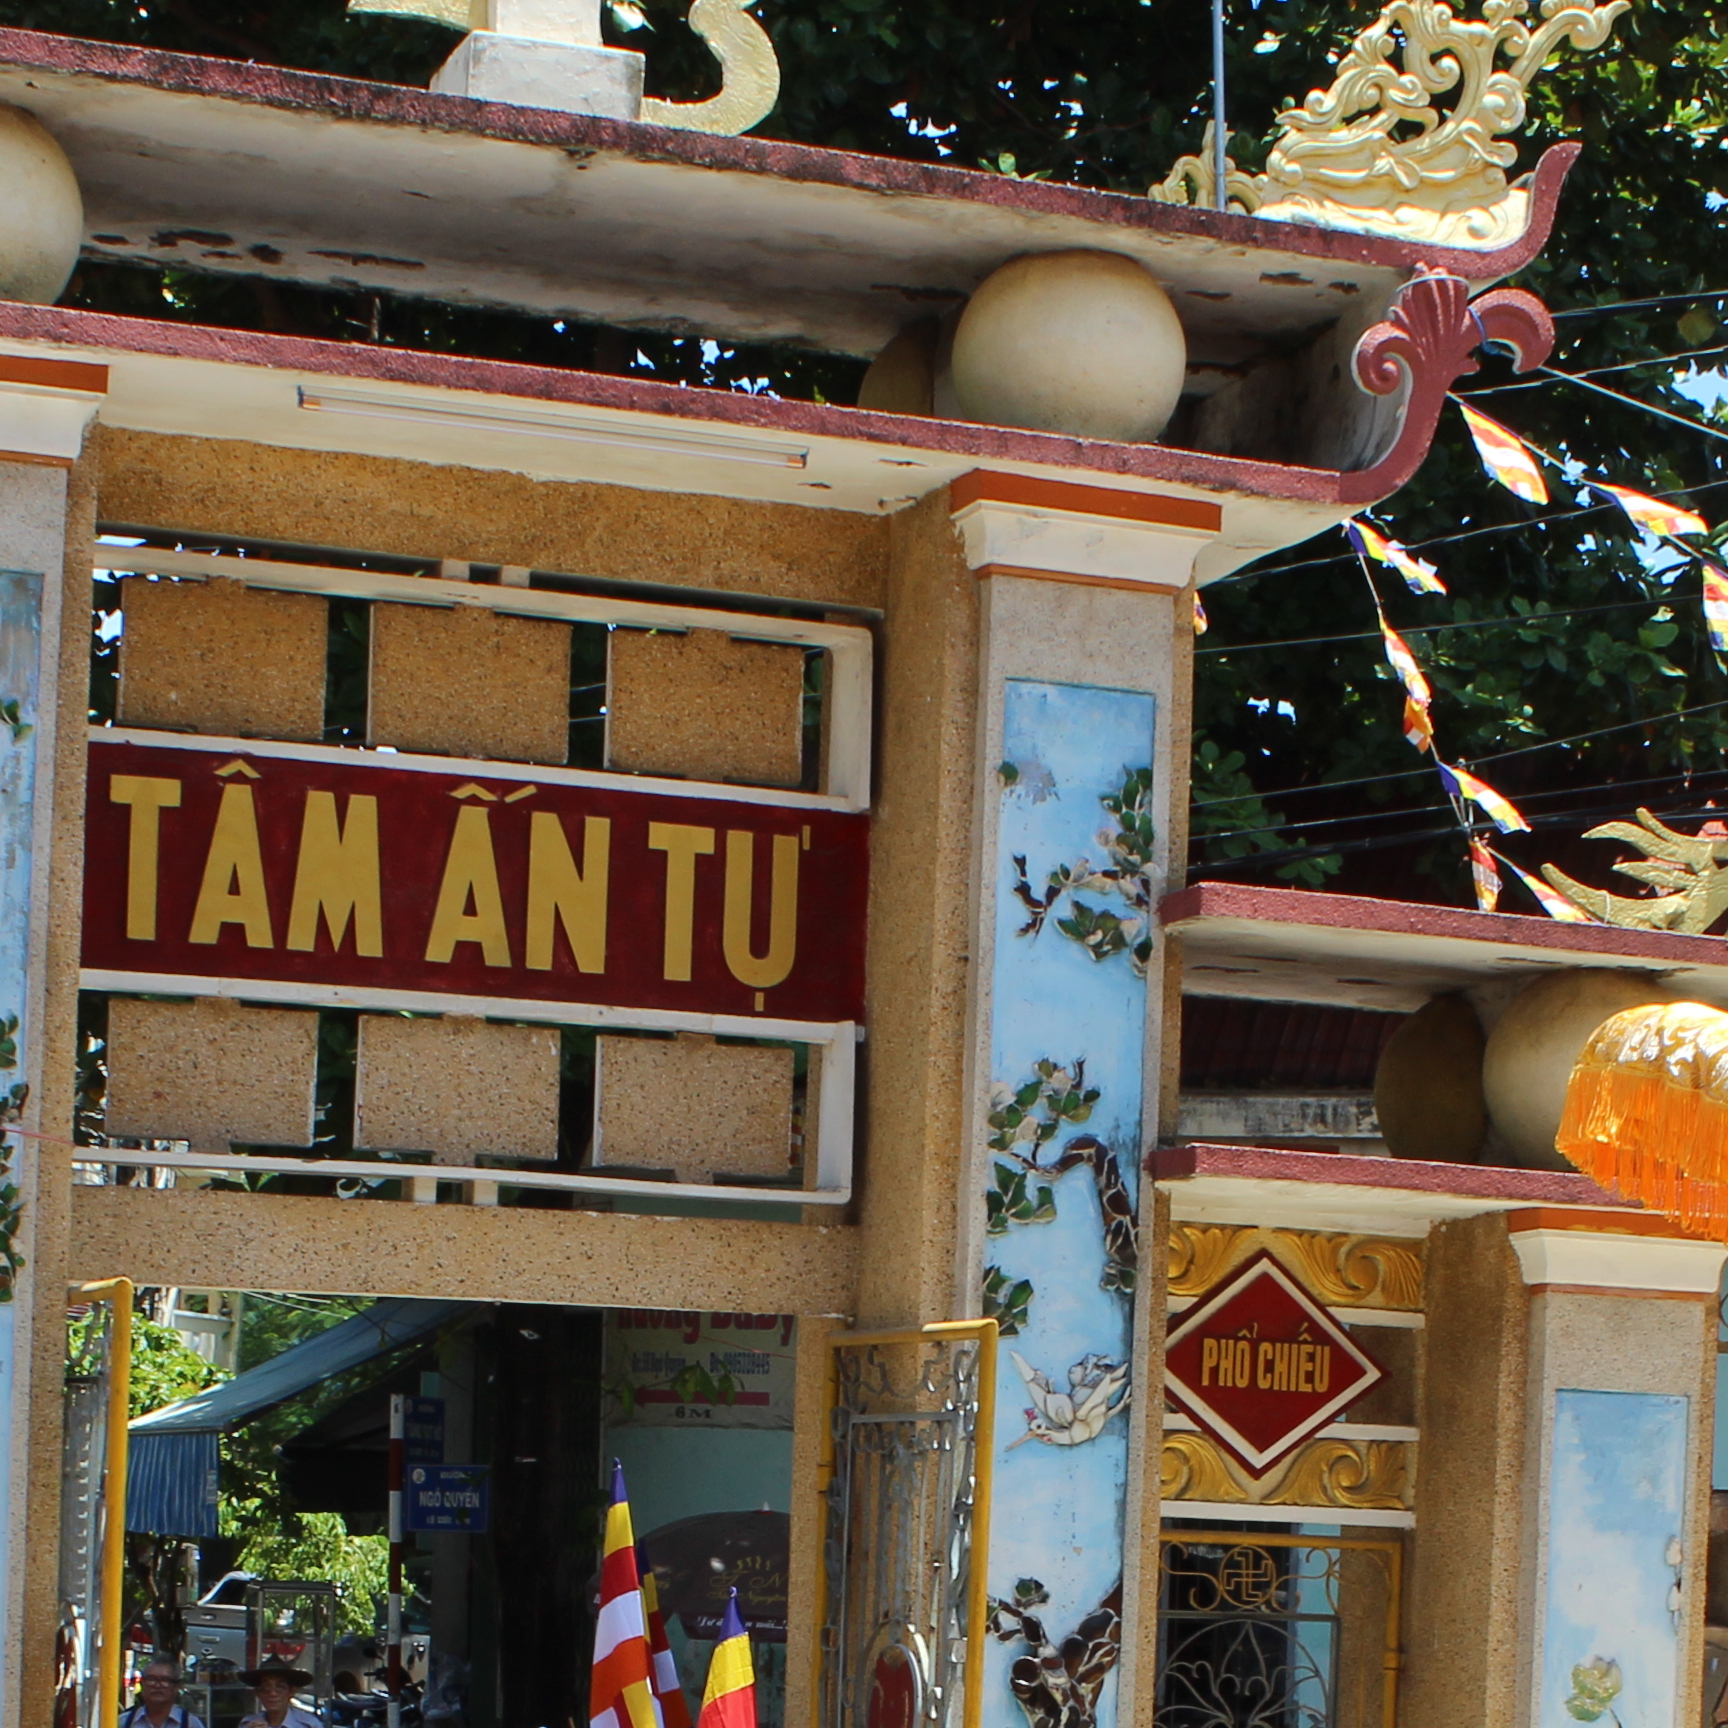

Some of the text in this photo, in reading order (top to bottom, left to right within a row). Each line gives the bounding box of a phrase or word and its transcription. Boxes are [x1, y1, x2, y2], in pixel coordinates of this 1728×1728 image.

[109, 759, 811, 1012] TÂM ẤN TỰ
[1201, 1321, 1331, 1393] PHỔ CHIẾU
